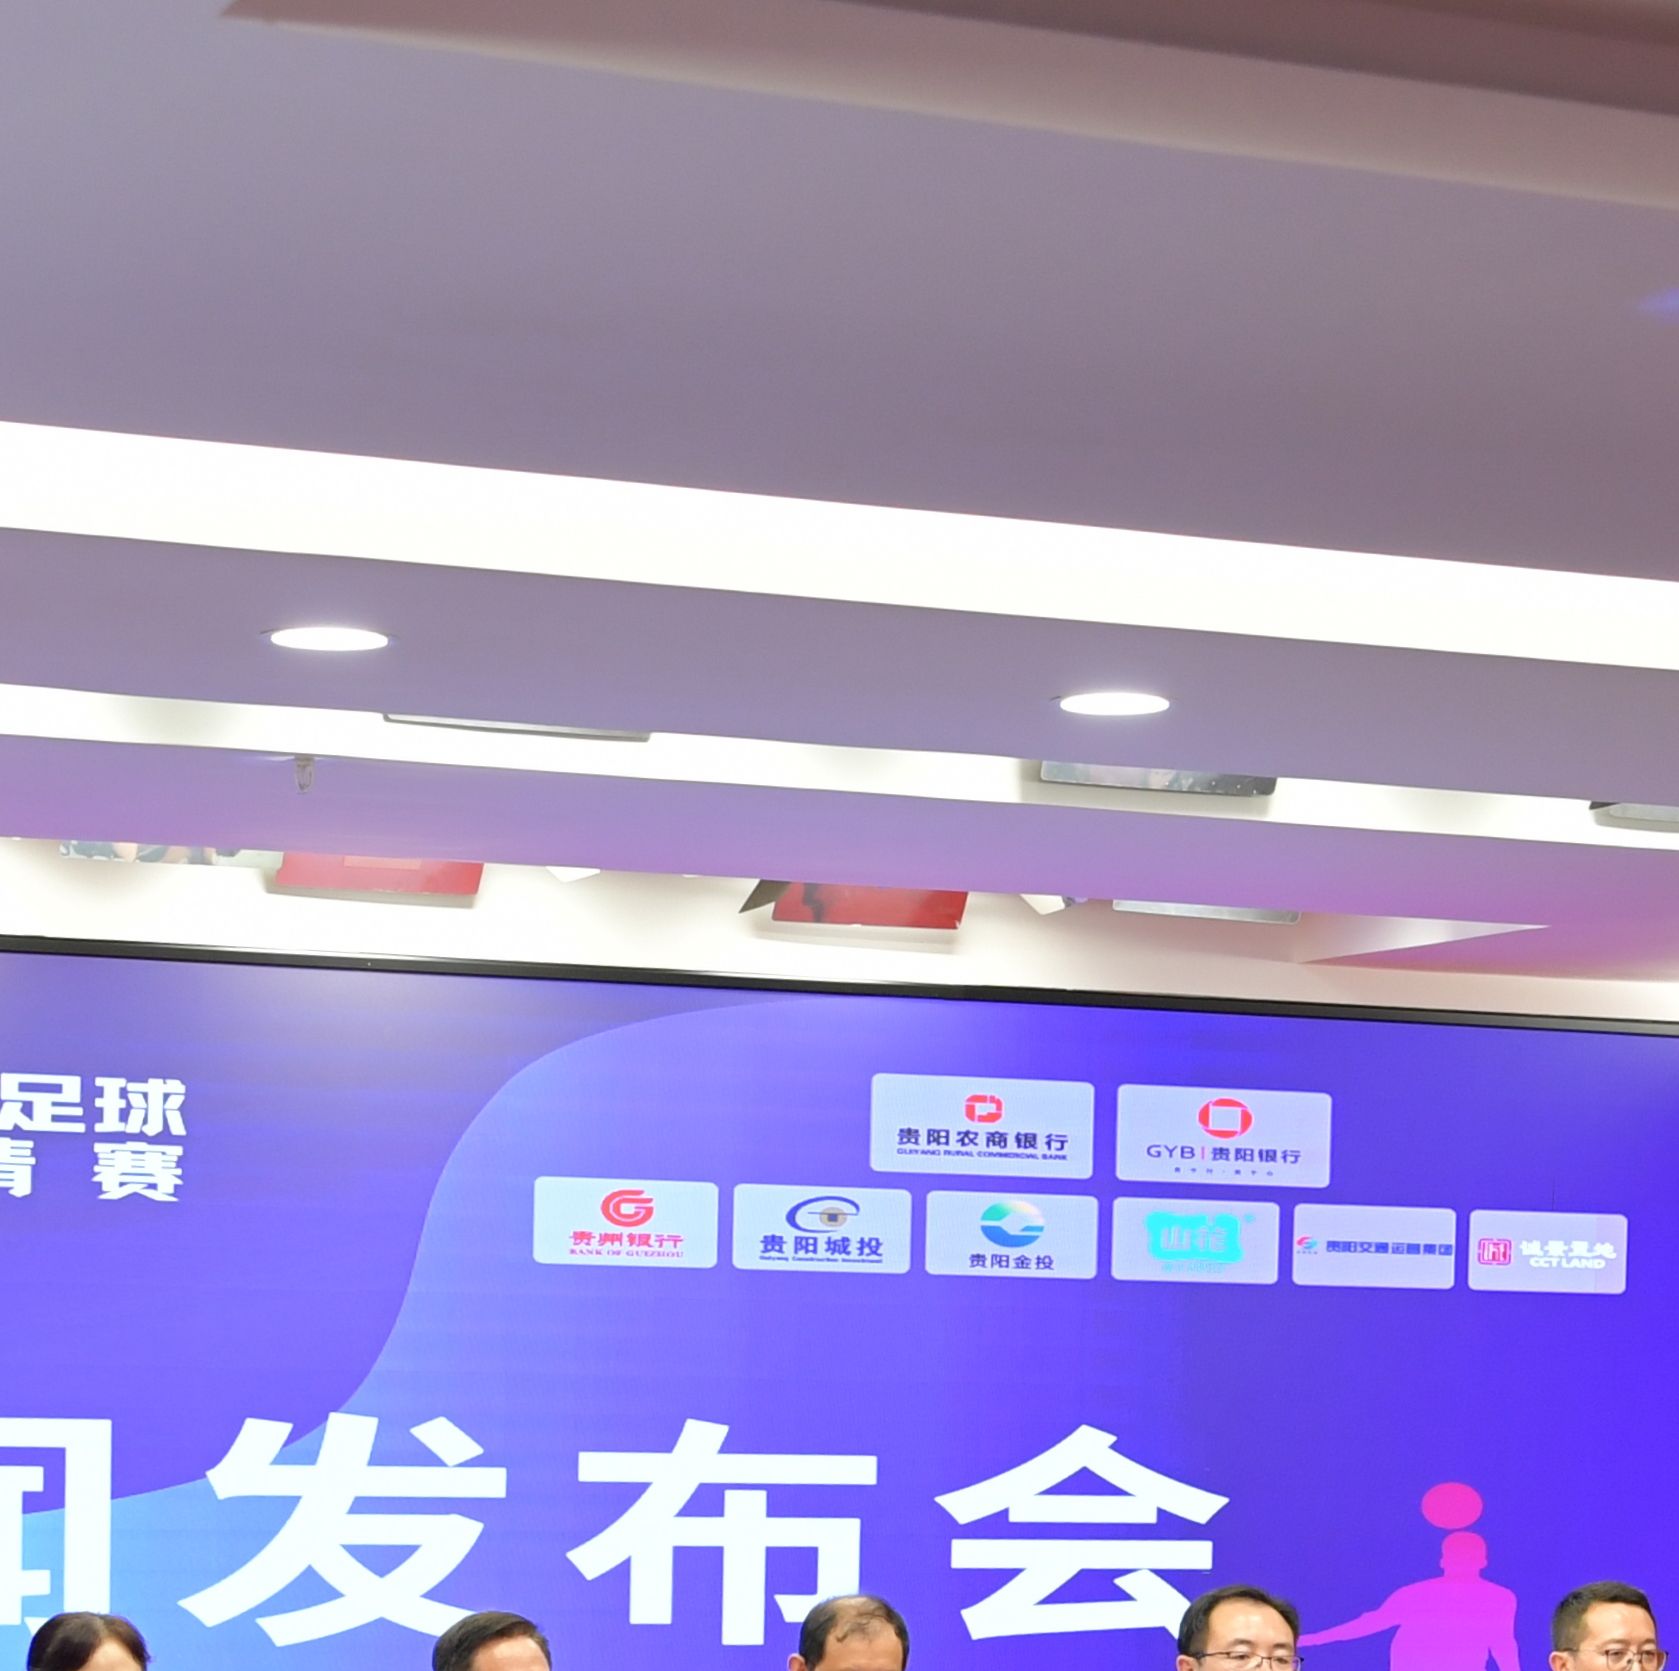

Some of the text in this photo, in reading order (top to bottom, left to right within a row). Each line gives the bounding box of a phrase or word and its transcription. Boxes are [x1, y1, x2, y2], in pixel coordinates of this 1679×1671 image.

[897, 1127, 1069, 1151] 贵阳农商银行
[1146, 1144, 1196, 1160] GYB
[1211, 1147, 1302, 1165] 贵阳银行
[568, 1231, 684, 1249] 贵州银行
[759, 1233, 884, 1257] 贵阳城投
[969, 1252, 1055, 1271] 贵阳金投
[1561, 1258, 1606, 1270] LAND
